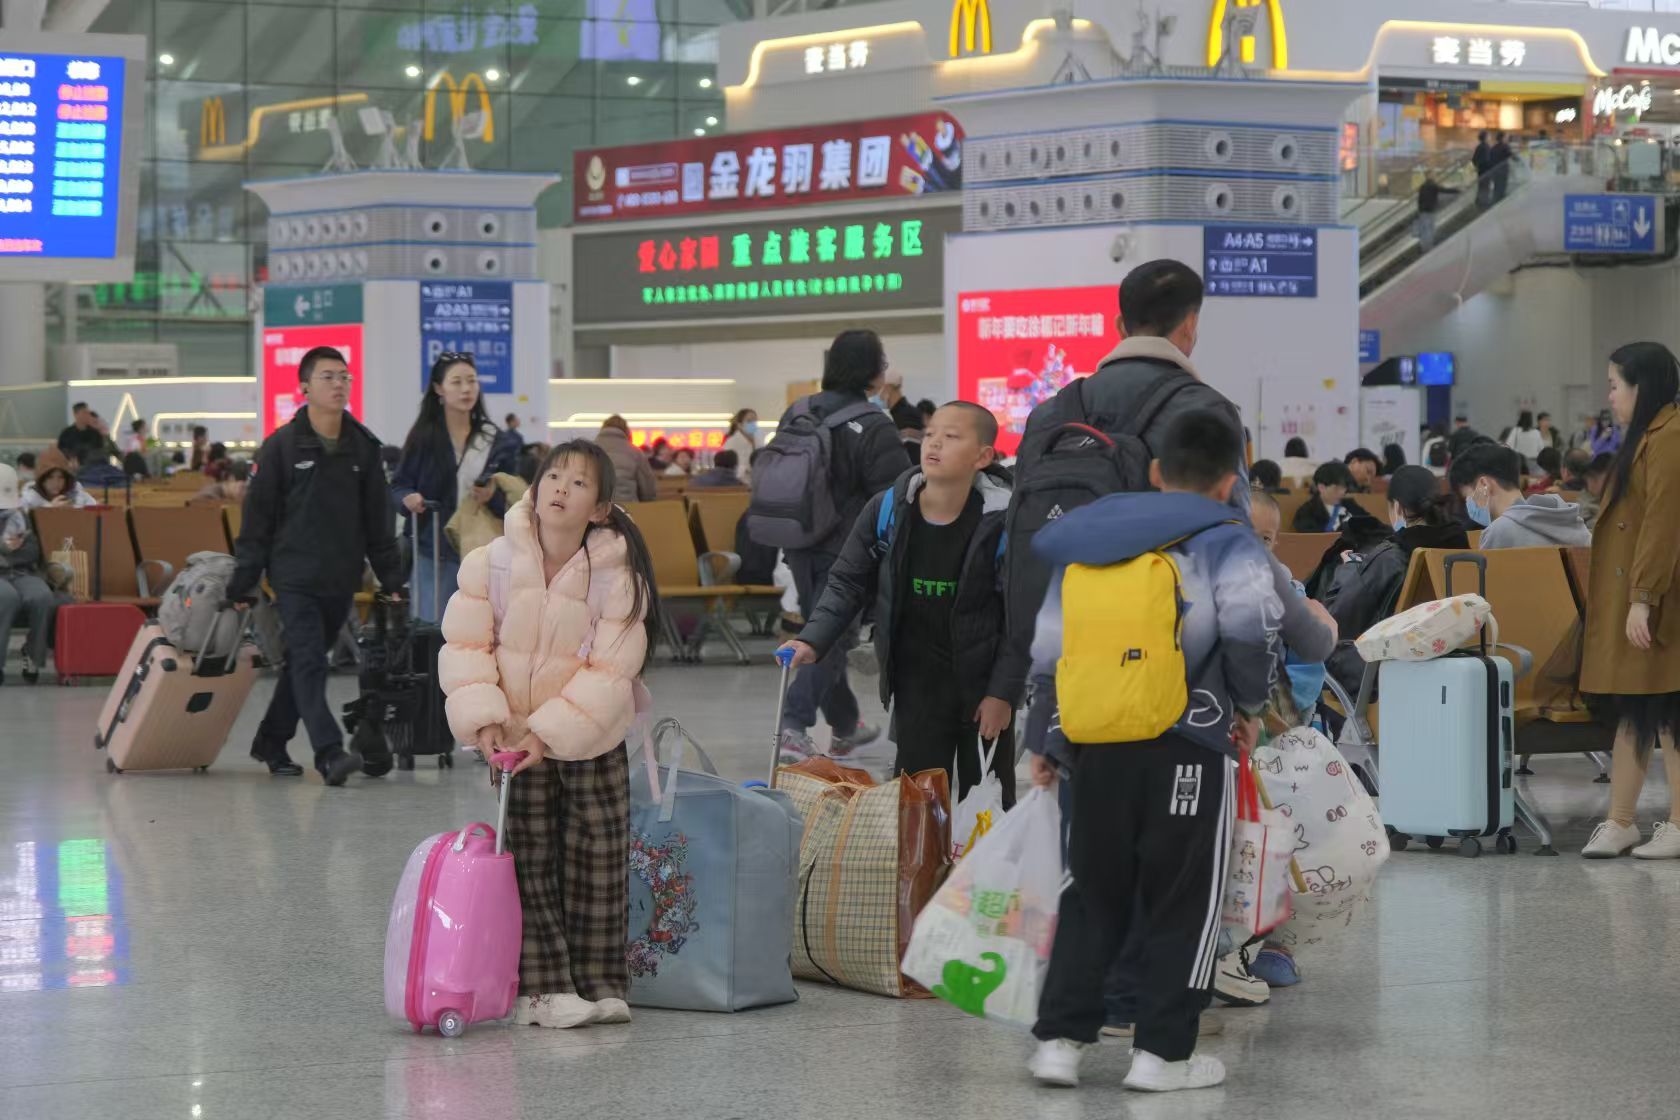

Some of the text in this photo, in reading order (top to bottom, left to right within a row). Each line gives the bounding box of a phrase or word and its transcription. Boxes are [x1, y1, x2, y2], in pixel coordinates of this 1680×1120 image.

[1433, 36, 1526, 67] 麦当劳
[708, 135, 892, 200] 金龙羽集团
[731, 219, 923, 268] 重点旅客服务区
[1249, 257, 1268, 273] A1
